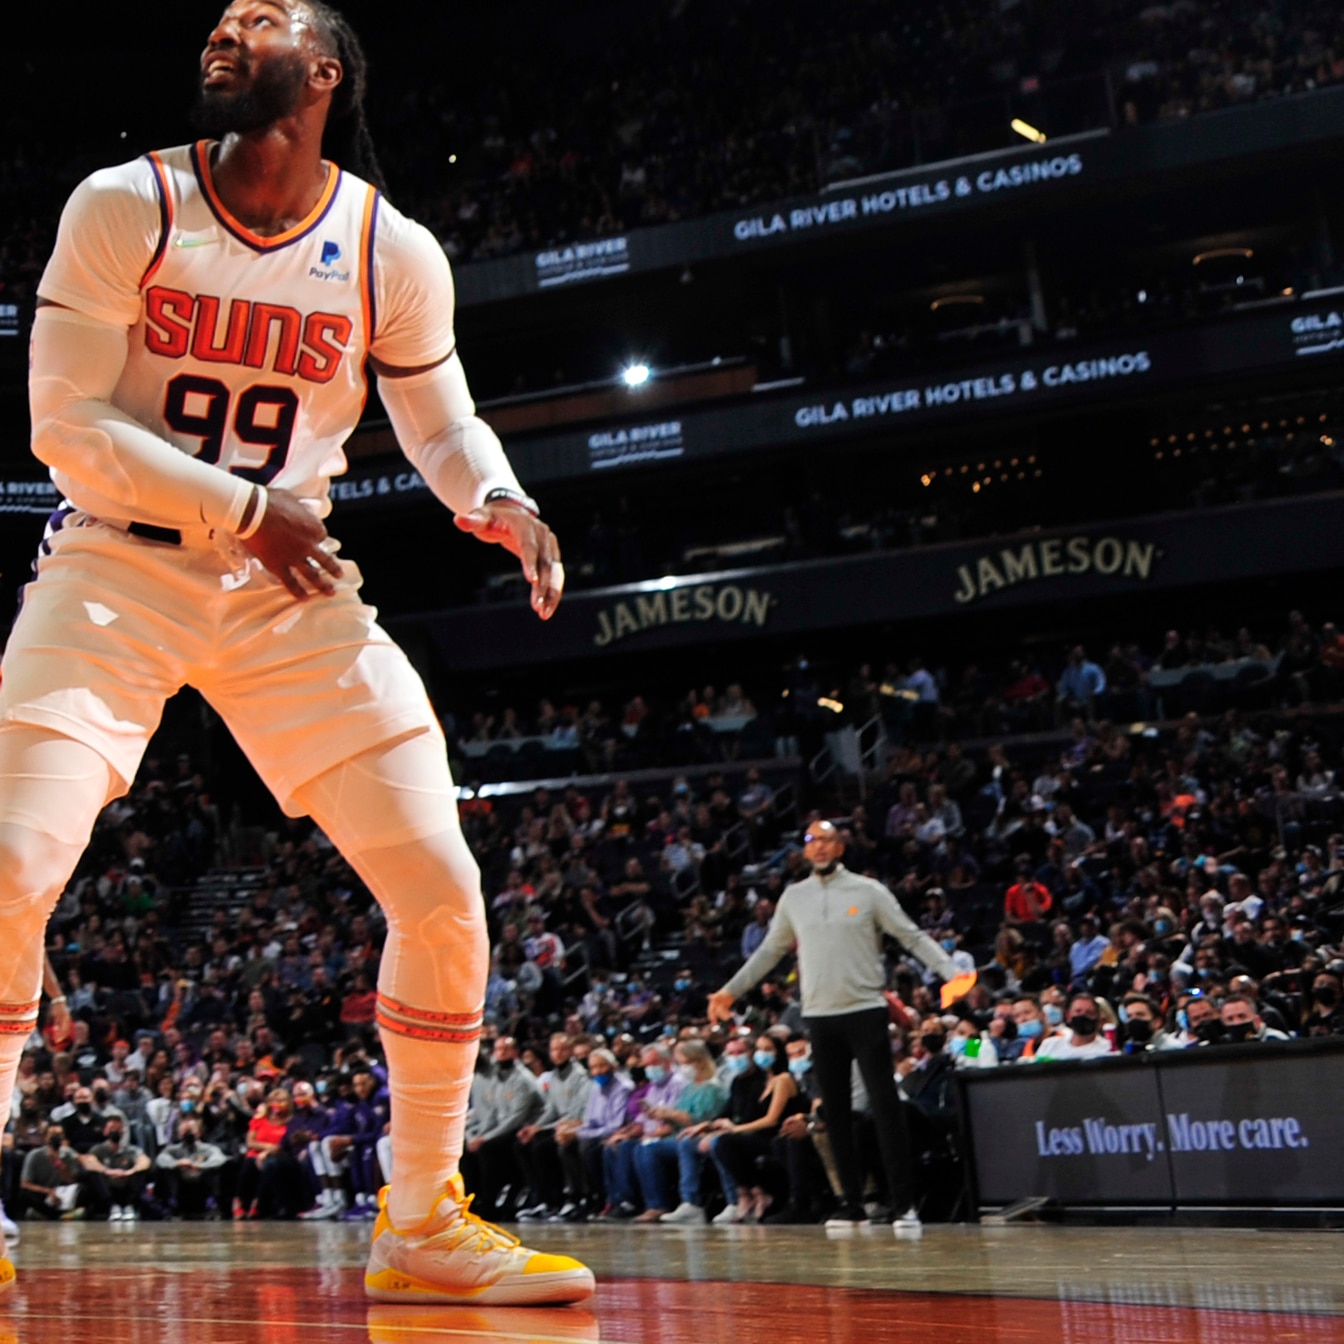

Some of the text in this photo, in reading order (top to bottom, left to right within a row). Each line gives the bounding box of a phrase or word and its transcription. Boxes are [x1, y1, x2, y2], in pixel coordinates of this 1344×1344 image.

[734, 154, 1083, 240] GILA RIVER HOTELS & CASINOS
[309, 267, 349, 282] PayPal
[145, 285, 353, 385] SUNS
[794, 351, 1152, 428] GILA RIVER HOTELS & CASINOS
[163, 373, 300, 487] 99
[377, 476, 391, 494] &
[954, 537, 1155, 603] JAMESON
[593, 585, 772, 647] JAMESON
[1036, 1113, 1309, 1161] Less Worry. More care.
